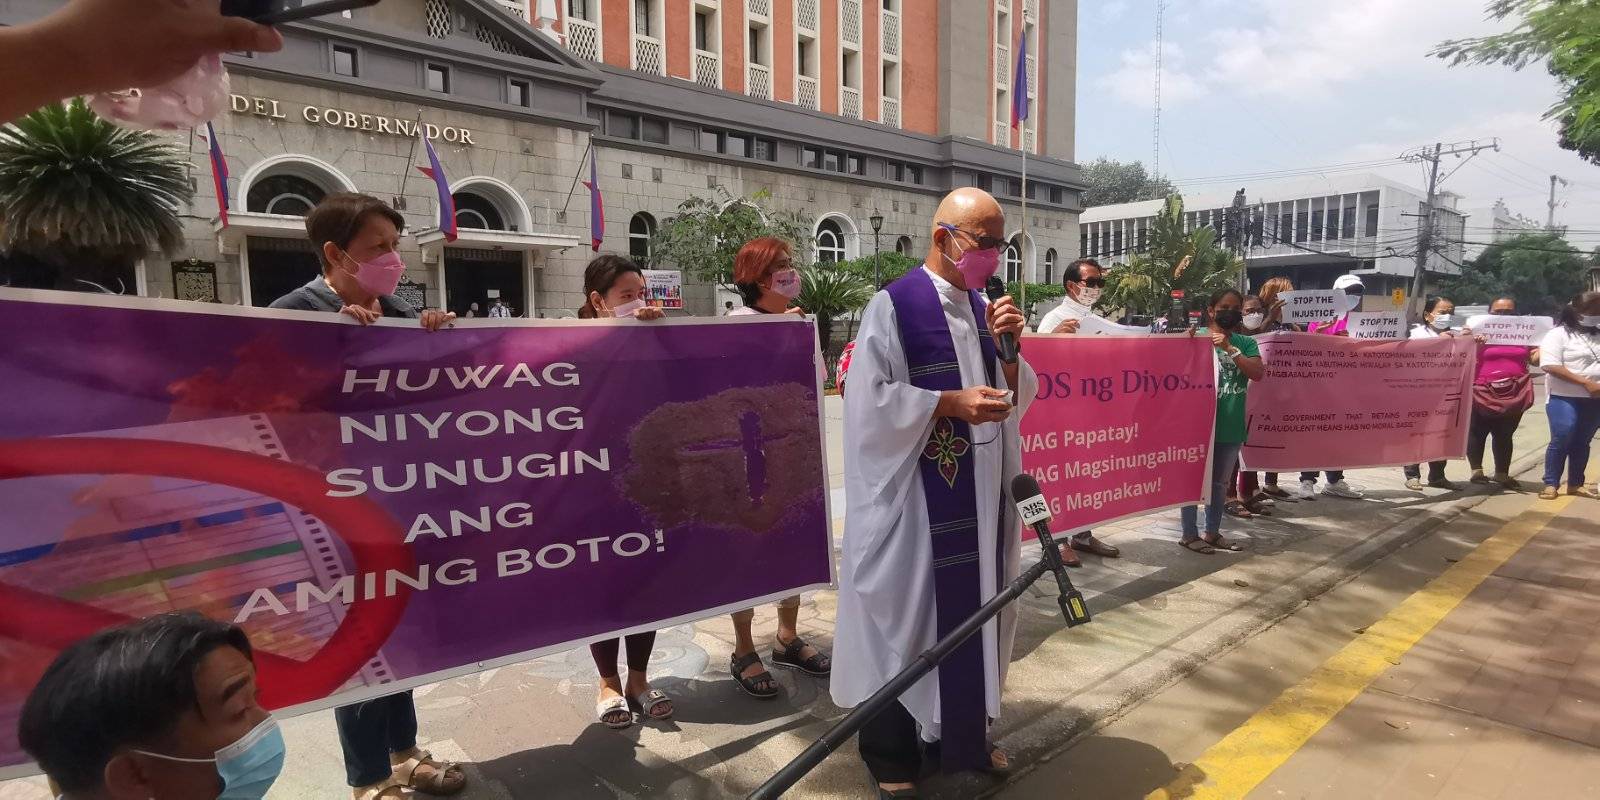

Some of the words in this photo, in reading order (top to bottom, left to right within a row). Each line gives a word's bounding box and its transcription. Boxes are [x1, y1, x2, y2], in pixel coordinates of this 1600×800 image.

[229, 93, 287, 119] DEL
[1293, 296, 1313, 304] STOP
[1315, 296, 1333, 304] THE
[1292, 309, 1334, 318] INJUSTICE
[1360, 318, 1380, 326] STOP
[342, 362, 581, 392] HUWAG
[1079, 377, 1114, 402] ng
[339, 406, 585, 444] NIYONG
[1064, 423, 1139, 449] Papatay!
[1258, 424, 1315, 432] FRAUDULENT
[325, 448, 611, 497] SUNUGIN
[1022, 501, 1044, 512] ABS
[1066, 477, 1162, 512] Magnakaw!
[403, 502, 534, 543] ANG
[1024, 506, 1047, 519] CBN
[233, 558, 478, 623] AMING
[498, 529, 665, 577] BOTO!
